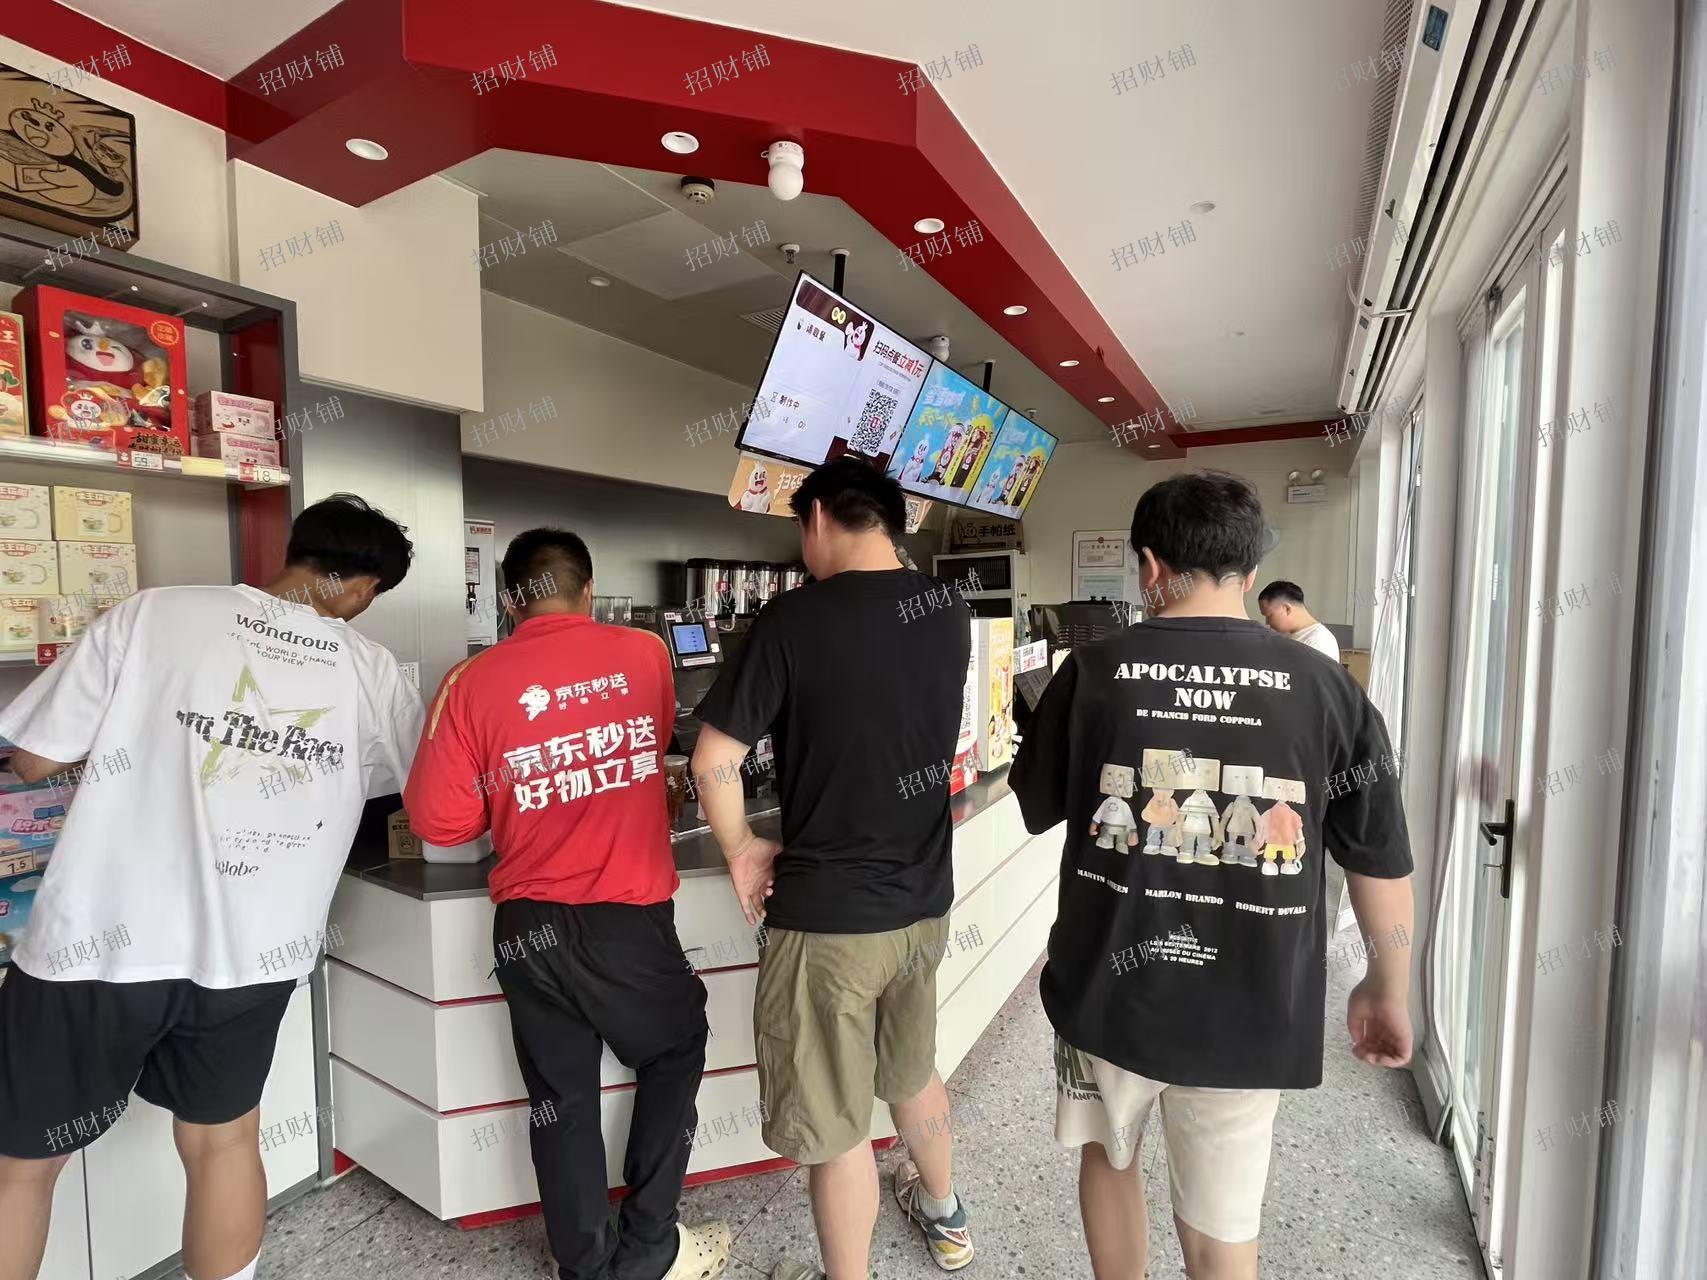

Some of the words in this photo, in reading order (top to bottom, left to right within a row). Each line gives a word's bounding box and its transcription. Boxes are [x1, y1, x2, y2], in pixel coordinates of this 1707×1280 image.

[873, 340, 924, 378] 扫码点餐立减1元
[779, 395, 800, 411] 制作中
[257, 469, 271, 482] 18
[979, 524, 1016, 537] 手帕纸
[236, 613, 339, 653] wondrous
[554, 673, 628, 702] 京东秒送
[1113, 663, 1291, 690] APOCALYPSE
[1174, 687, 1237, 710] NOW
[1136, 709, 1149, 717] DE
[1152, 710, 1189, 721] FRANCIS
[1192, 713, 1217, 723] FORD
[1219, 715, 1262, 726] COPPOLA
[220, 711, 279, 753] The
[502, 715, 658, 780] 京东秒送
[513, 750, 659, 813] 好物立享
[1144, 889, 1182, 899] MARLON
[1185, 893, 1224, 905] BRANDO
[1235, 901, 1275, 915] ROBERT
[1278, 905, 1307, 916] DUVALL
